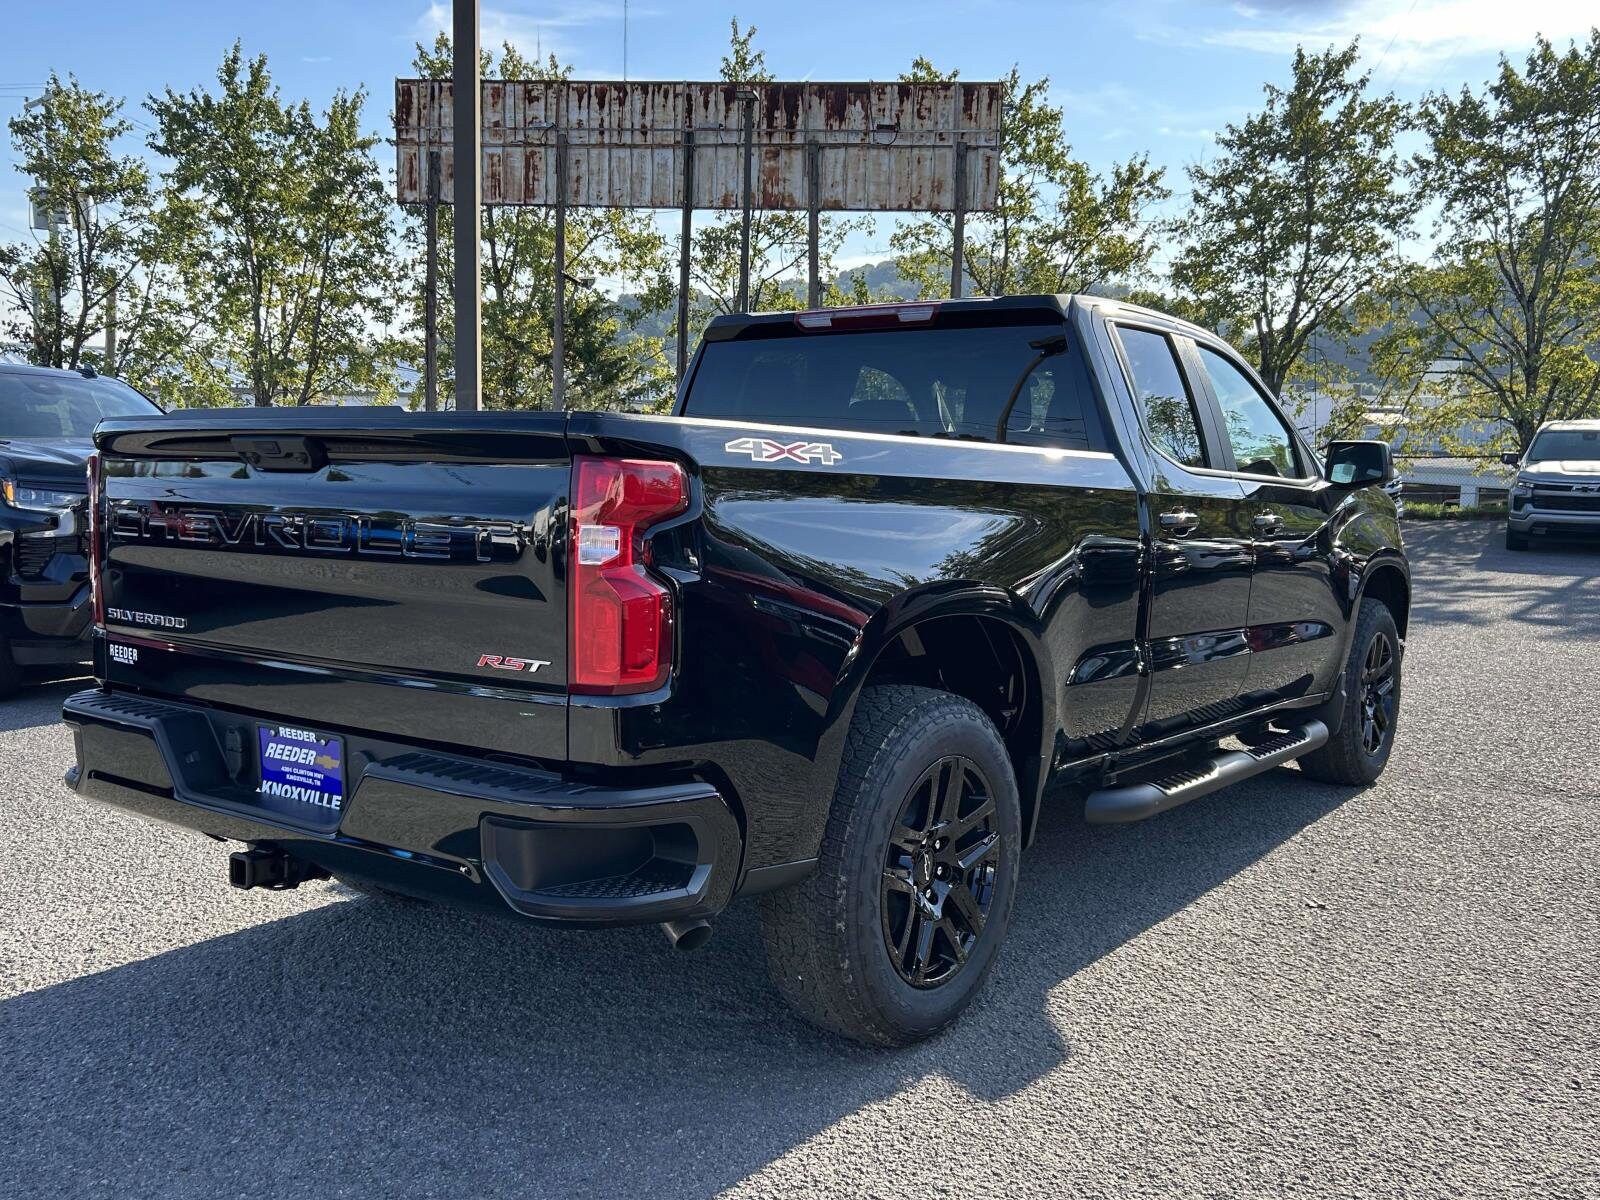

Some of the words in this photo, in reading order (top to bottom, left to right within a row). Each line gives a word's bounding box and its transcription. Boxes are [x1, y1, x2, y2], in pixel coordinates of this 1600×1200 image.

[111, 503, 517, 562] CHEVROLET
[107, 602, 187, 629] SILVERADO
[109, 643, 138, 661] REEDER
[476, 653, 552, 673] RST
[278, 726, 317, 743] REEDER
[265, 742, 317, 766] REEDER
[261, 780, 342, 810] KNOXVILLE
